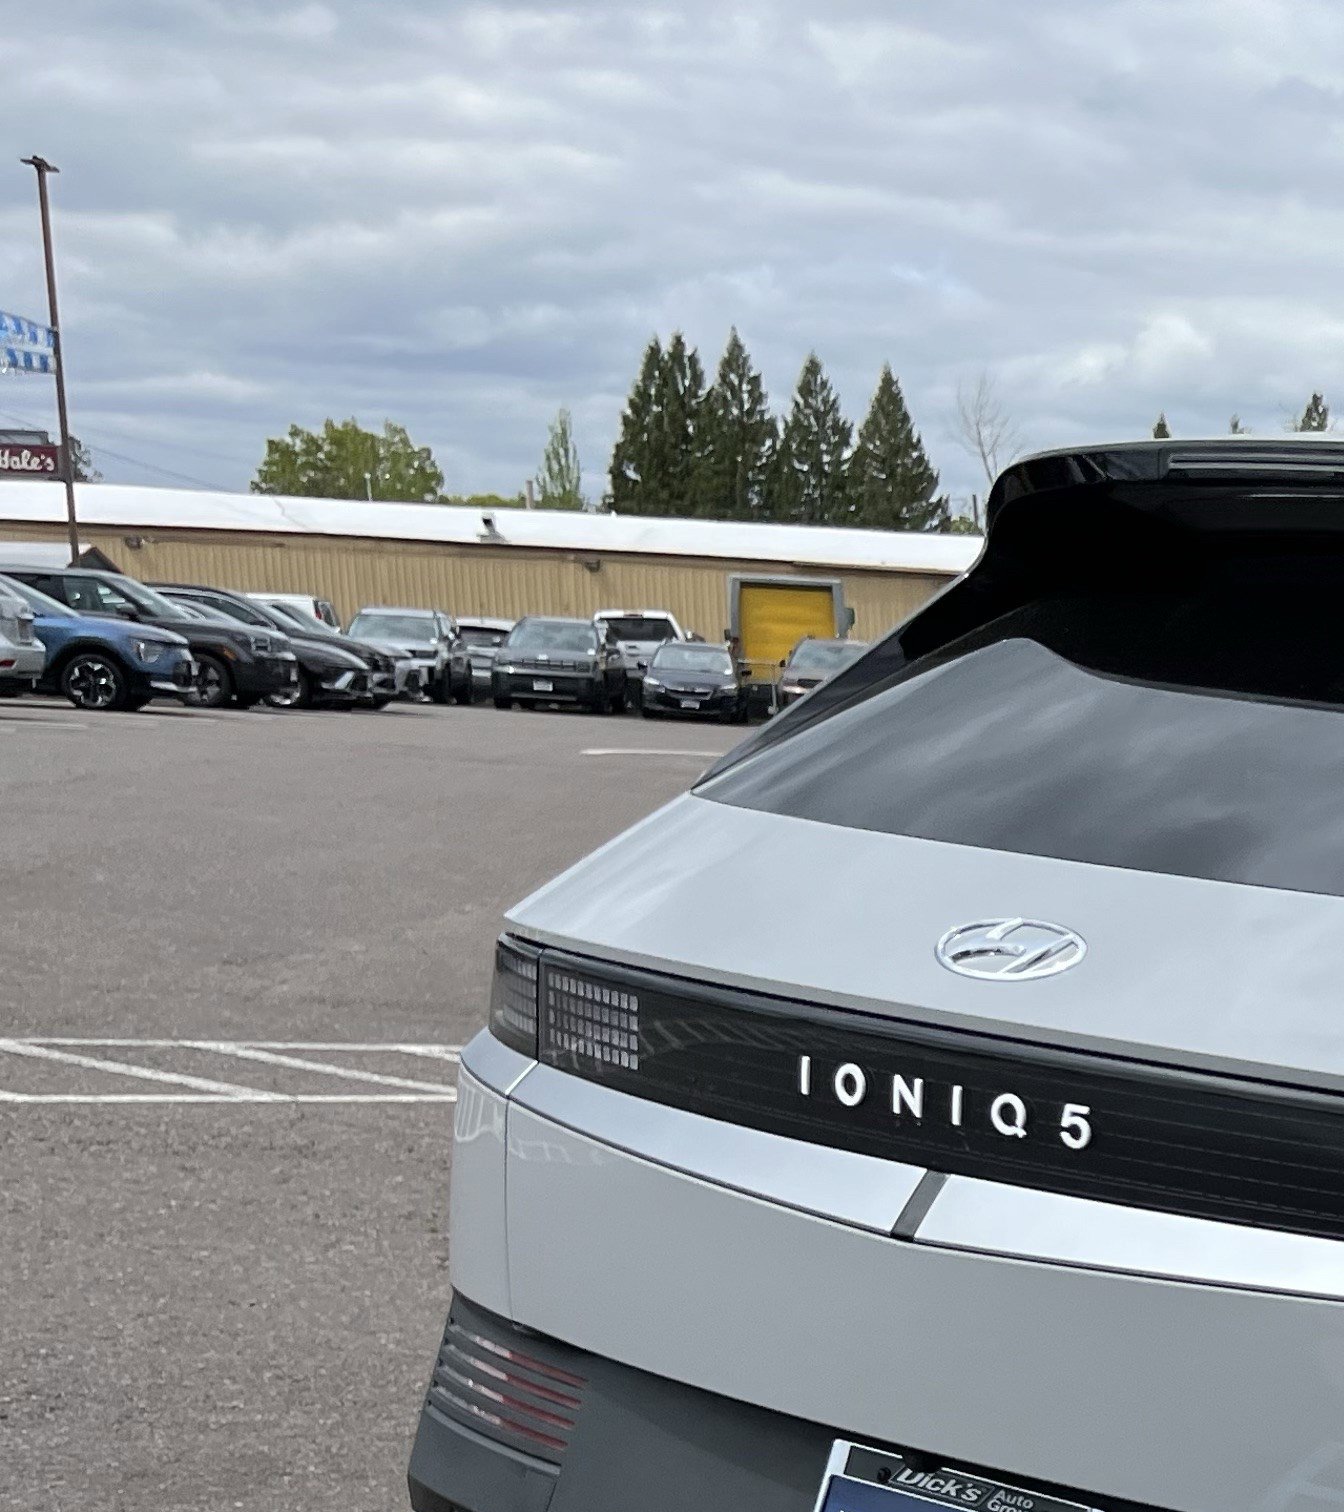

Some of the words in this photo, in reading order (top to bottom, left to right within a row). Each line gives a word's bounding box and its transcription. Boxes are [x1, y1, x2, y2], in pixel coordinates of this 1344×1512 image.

[800, 1055, 1027, 1138] IONIQ
[1060, 1103, 1092, 1149] 5
[896, 1467, 982, 1502] Dick's
[993, 1489, 1034, 1510] Auto
